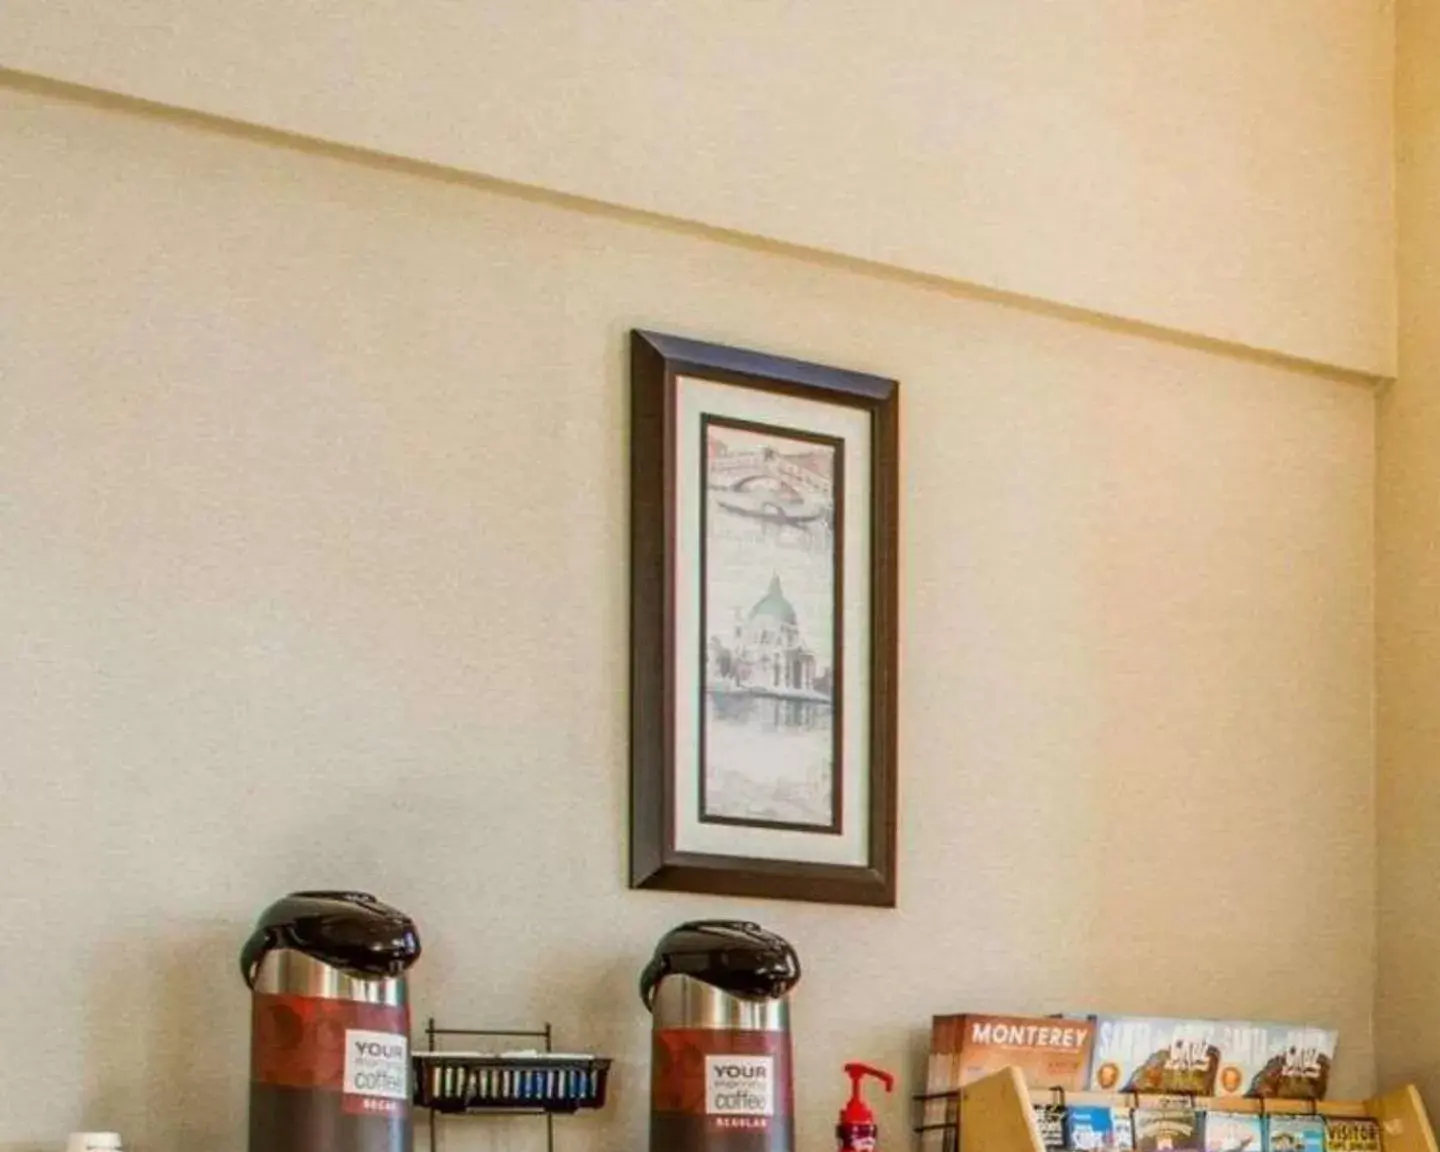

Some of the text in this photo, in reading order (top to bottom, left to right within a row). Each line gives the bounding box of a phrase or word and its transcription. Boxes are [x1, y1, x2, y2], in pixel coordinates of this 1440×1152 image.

[972, 1023, 1089, 1048] MONTEREY
[713, 1065, 767, 1079] YOUR
[714, 1089, 767, 1110] coffee
[1328, 1121, 1377, 1140] VISITOR
